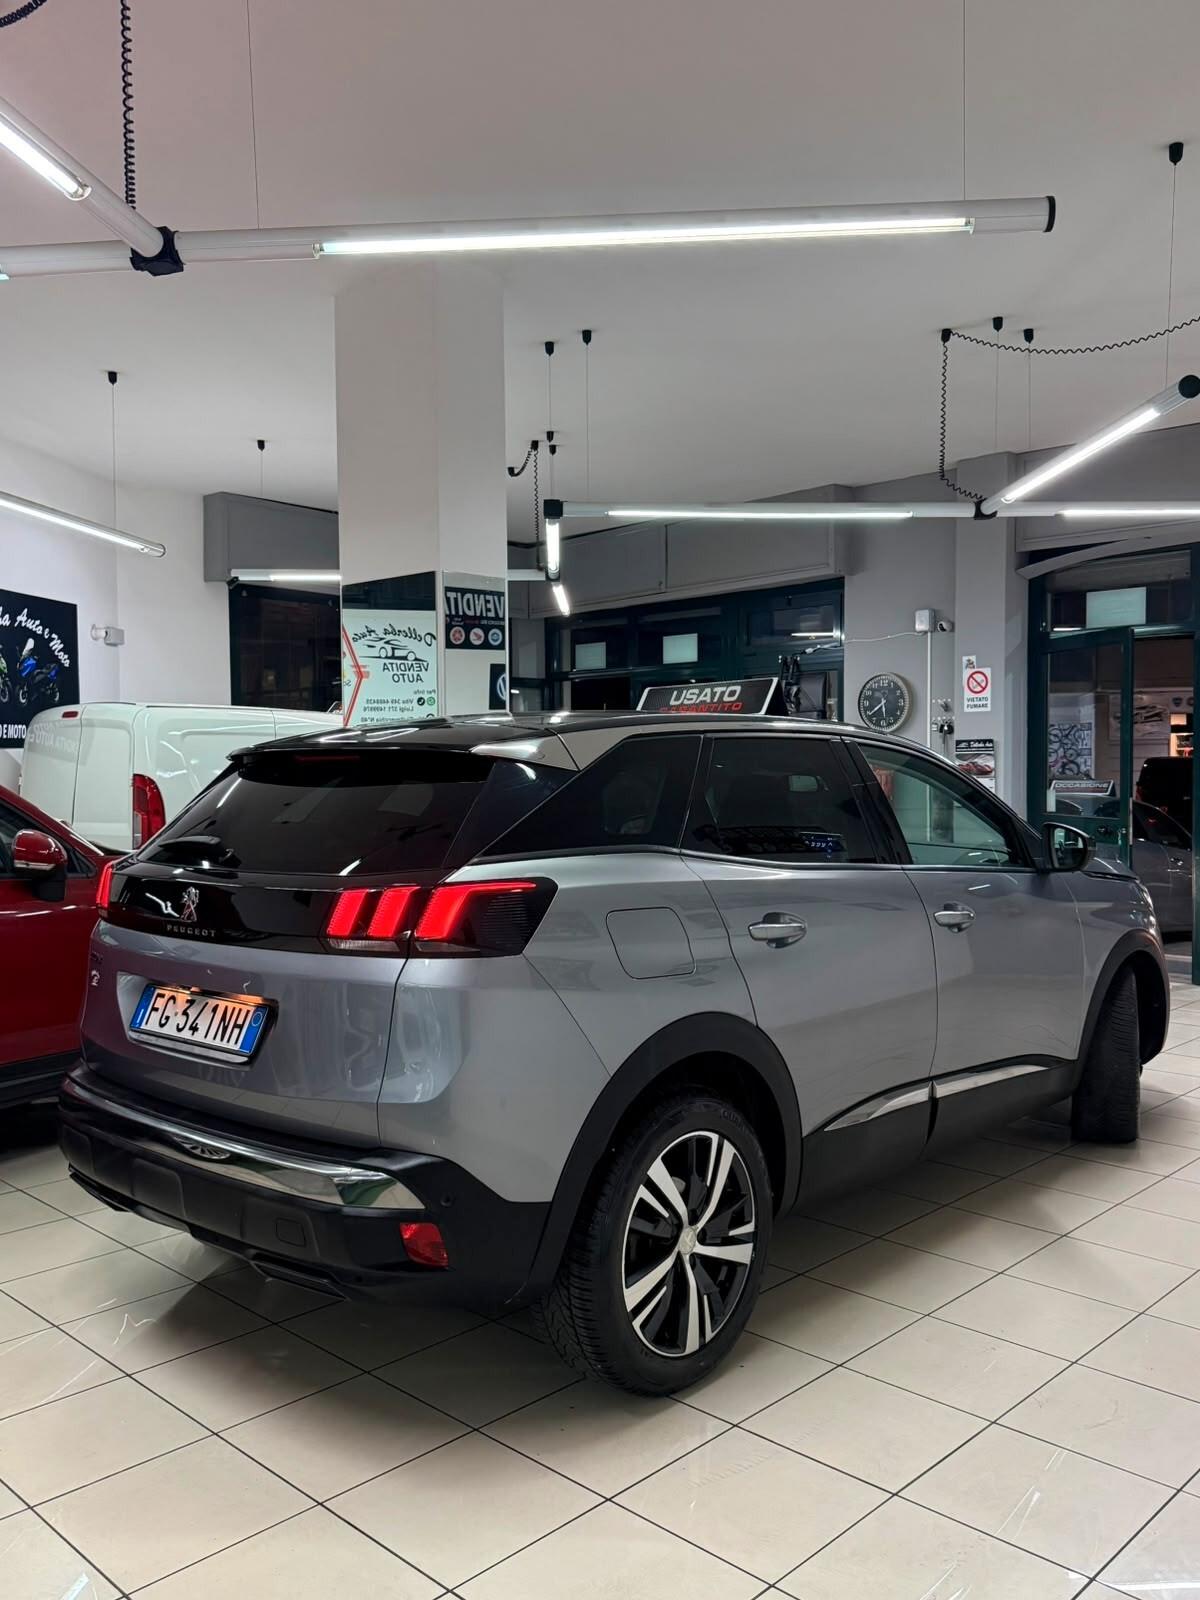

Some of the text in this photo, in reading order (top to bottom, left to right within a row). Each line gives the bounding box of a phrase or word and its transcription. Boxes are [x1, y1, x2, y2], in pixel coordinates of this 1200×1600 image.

[14, 608, 43, 634] Auto
[49, 633, 70, 667] Moto
[669, 685, 742, 705] USATO
[3, 725, 8, 739] E
[8, 725, 27, 739] MOTO
[166, 924, 217, 937] PEUGEOT
